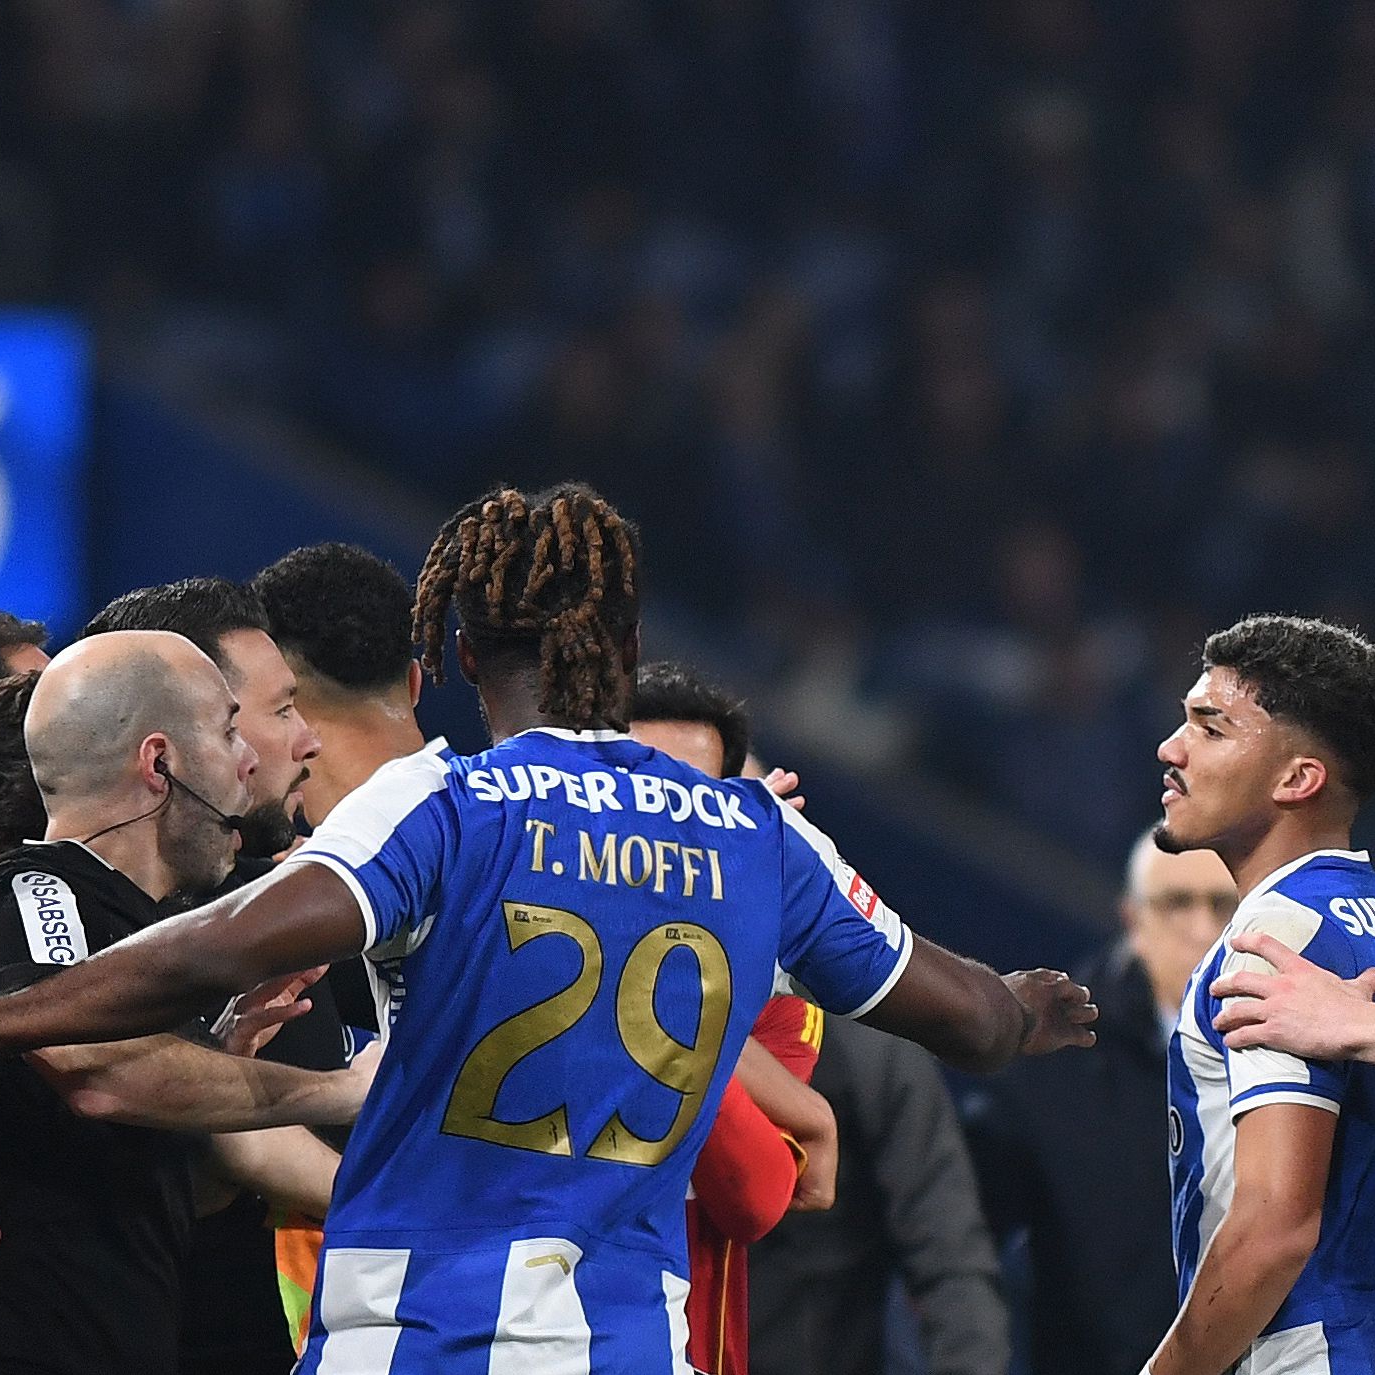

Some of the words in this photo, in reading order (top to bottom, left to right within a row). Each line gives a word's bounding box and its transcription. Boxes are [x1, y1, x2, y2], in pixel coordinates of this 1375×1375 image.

[467, 764, 623, 813] SUPER
[629, 772, 758, 830] BOCK
[525, 818, 565, 872] T.
[577, 830, 724, 900] MOFFI
[31, 886, 76, 964] SABSEG
[440, 900, 733, 1168] 29
